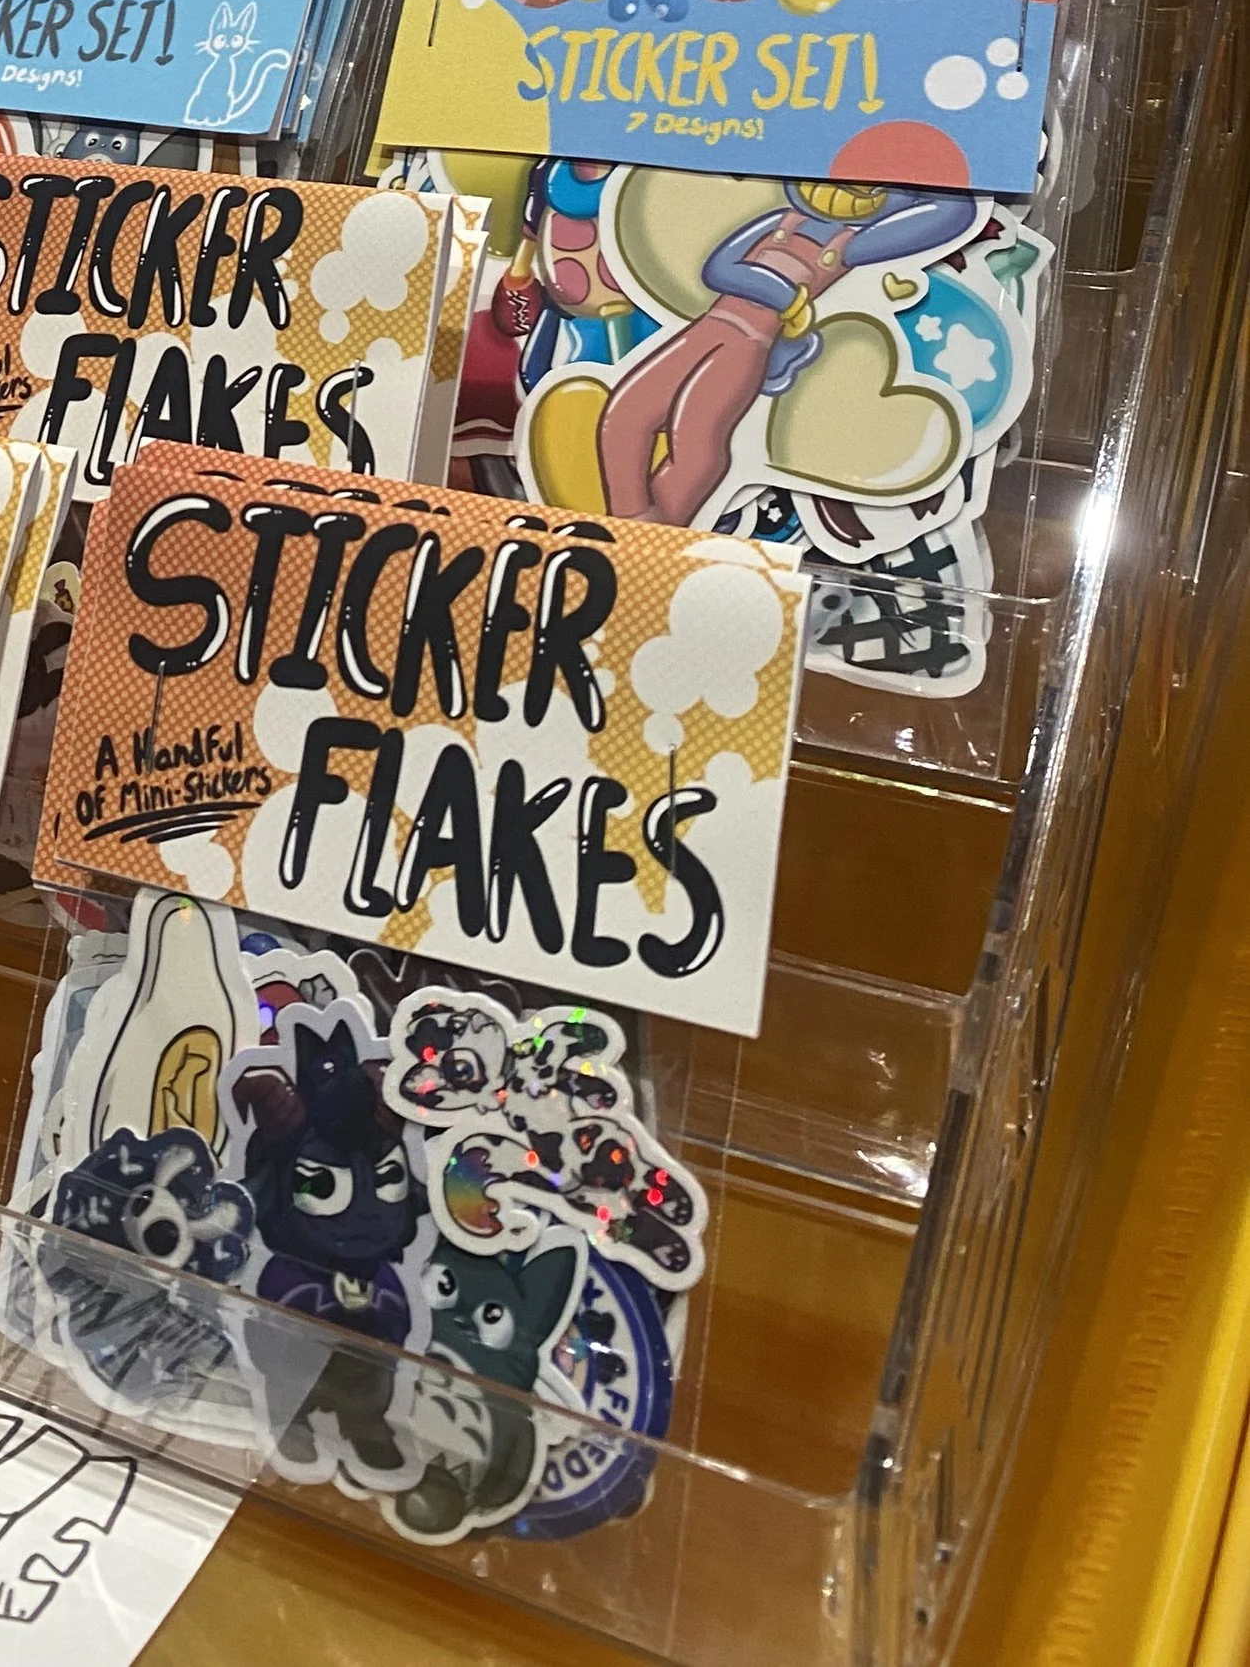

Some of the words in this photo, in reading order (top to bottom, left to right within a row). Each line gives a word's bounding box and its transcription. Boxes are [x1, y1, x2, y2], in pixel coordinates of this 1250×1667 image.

[1, 66, 83, 92] Designs!
[516, 26, 741, 109] STICKER
[752, 31, 886, 115] SET!
[625, 111, 649, 135] 7
[654, 112, 766, 142] Designs!
[38, 332, 376, 487] FLAKES
[126, 491, 618, 734] STICKER
[94, 734, 120, 781] A
[132, 720, 244, 777] Handful
[277, 716, 726, 981] FLAKES
